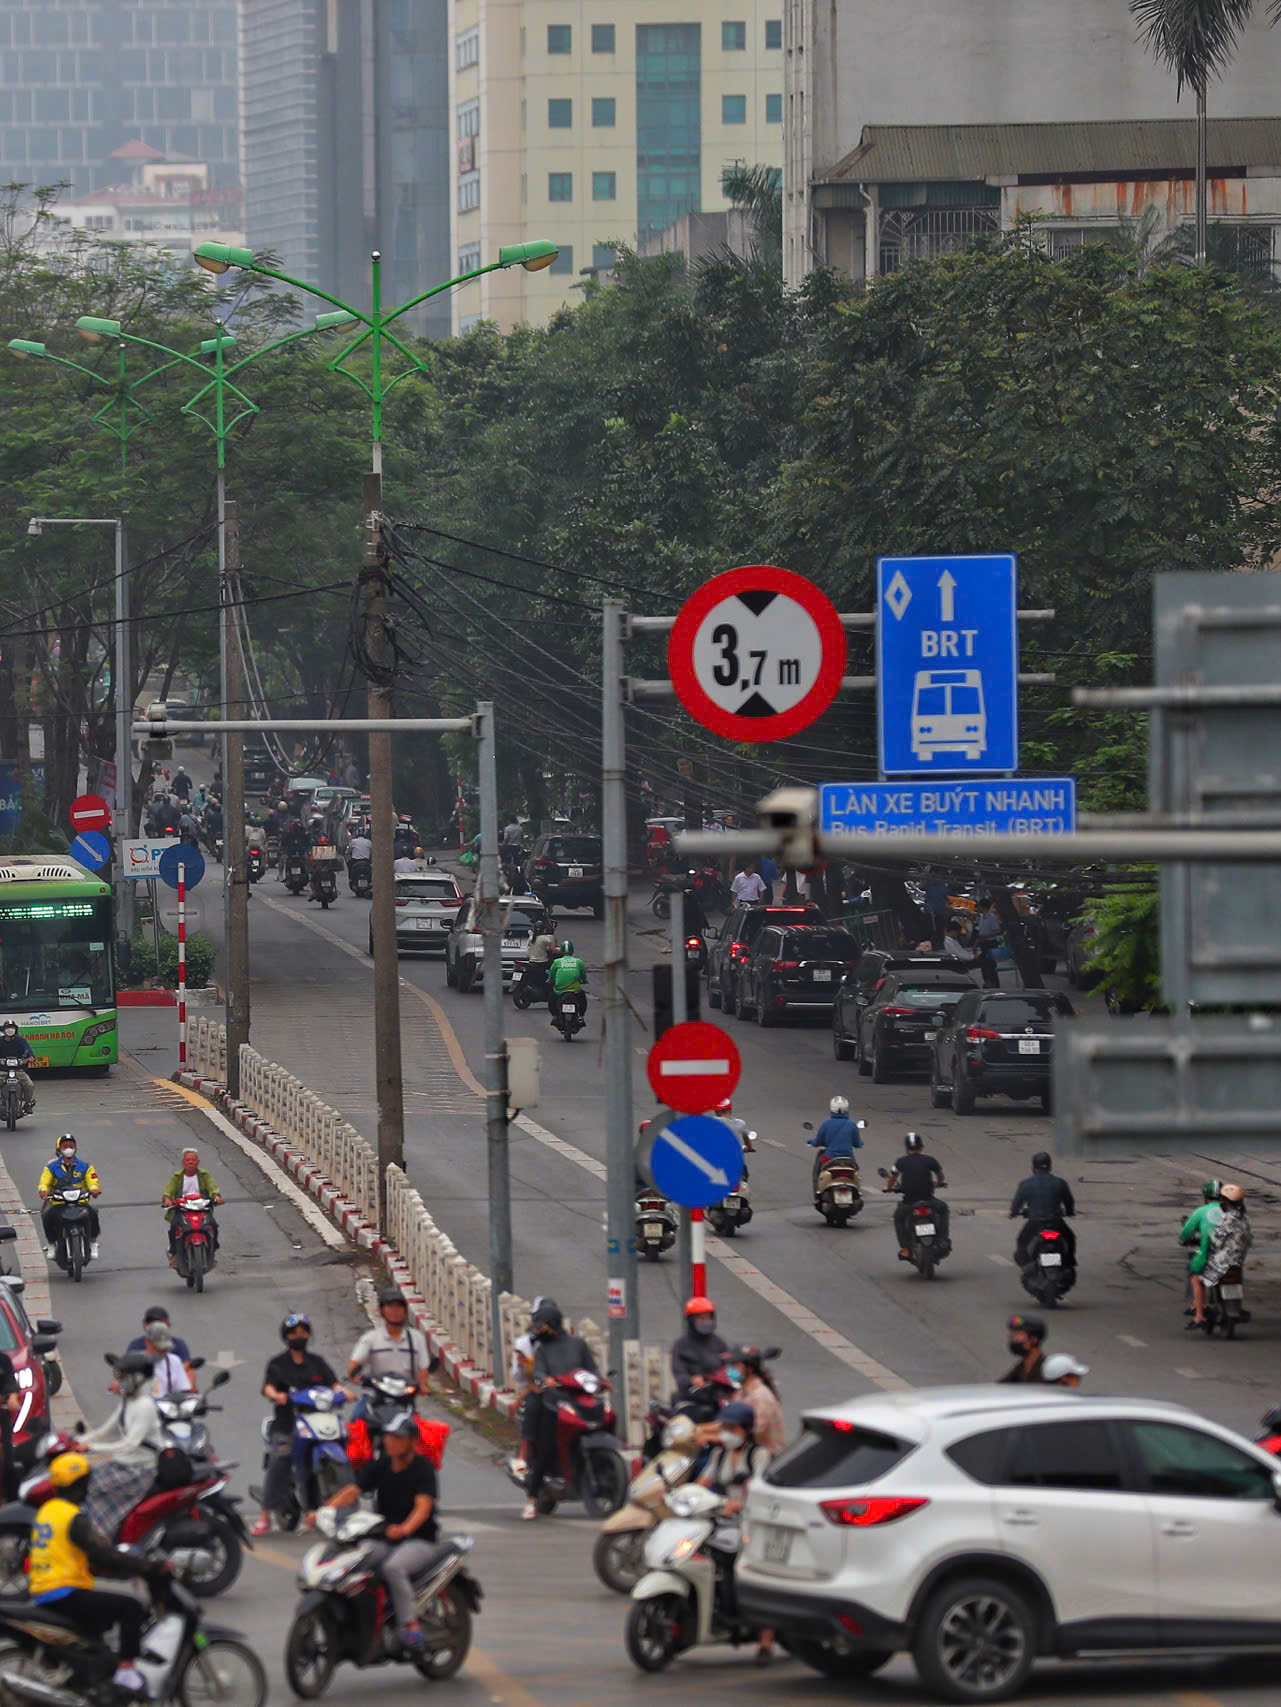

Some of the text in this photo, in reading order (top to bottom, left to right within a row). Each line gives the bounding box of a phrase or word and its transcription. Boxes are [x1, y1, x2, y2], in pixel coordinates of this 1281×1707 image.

[712, 623, 800, 692] 3,7 m
[921, 629, 978, 658] BRT
[830, 786, 1065, 815] LÀN XE BUÝT NHANH
[831, 815, 1065, 838] Bus Rapid Transit (BRT)
